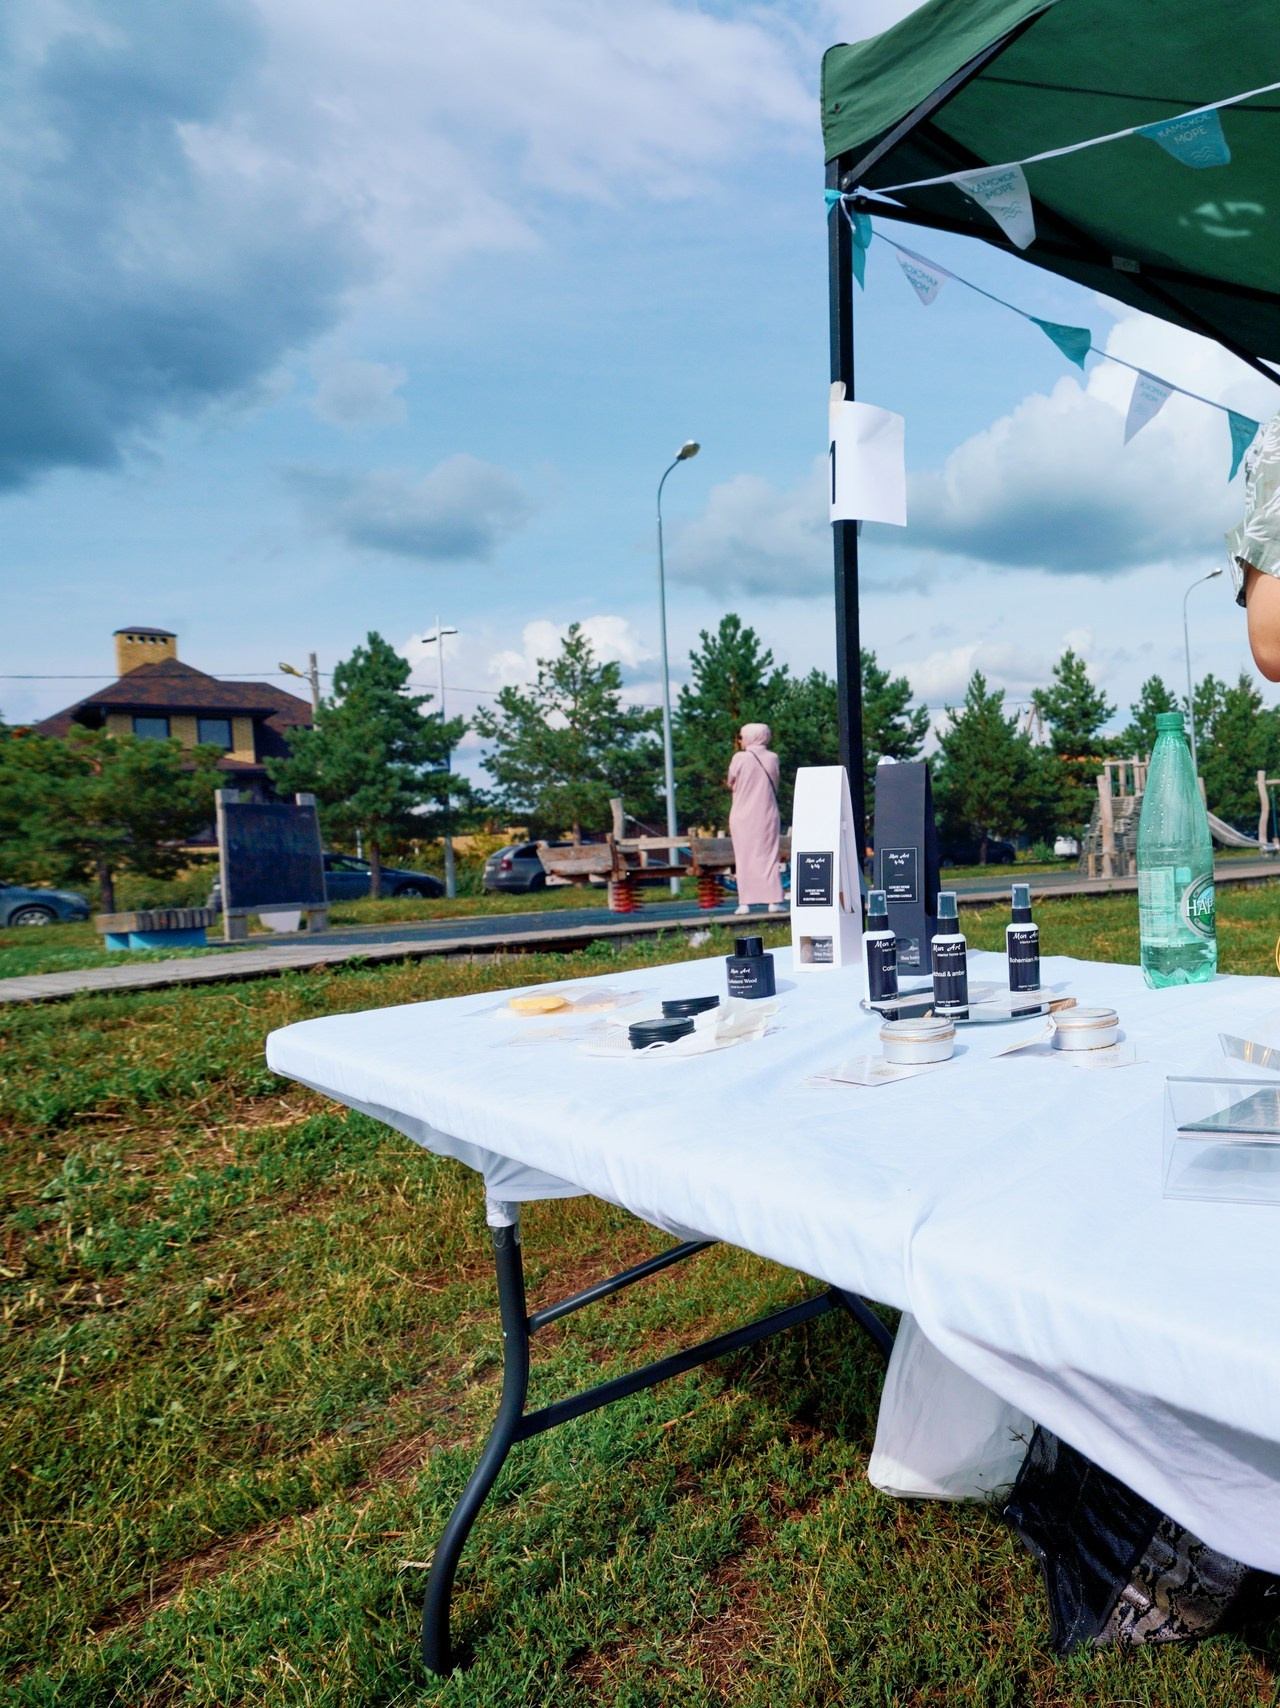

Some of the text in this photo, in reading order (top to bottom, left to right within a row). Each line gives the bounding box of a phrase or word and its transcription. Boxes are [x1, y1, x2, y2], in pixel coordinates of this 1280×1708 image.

[1157, 112, 1212, 138] КАМСКОЕ
[1174, 125, 1208, 145] МОРЕ
[968, 171, 1018, 194] КАМСКОЕ
[985, 182, 1015, 200] МОРЕ
[1185, 898, 1214, 918] НАР
[874, 940, 890, 948] Mon
[1012, 932, 1028, 940] Mon
[933, 943, 961, 952] Mon Art
